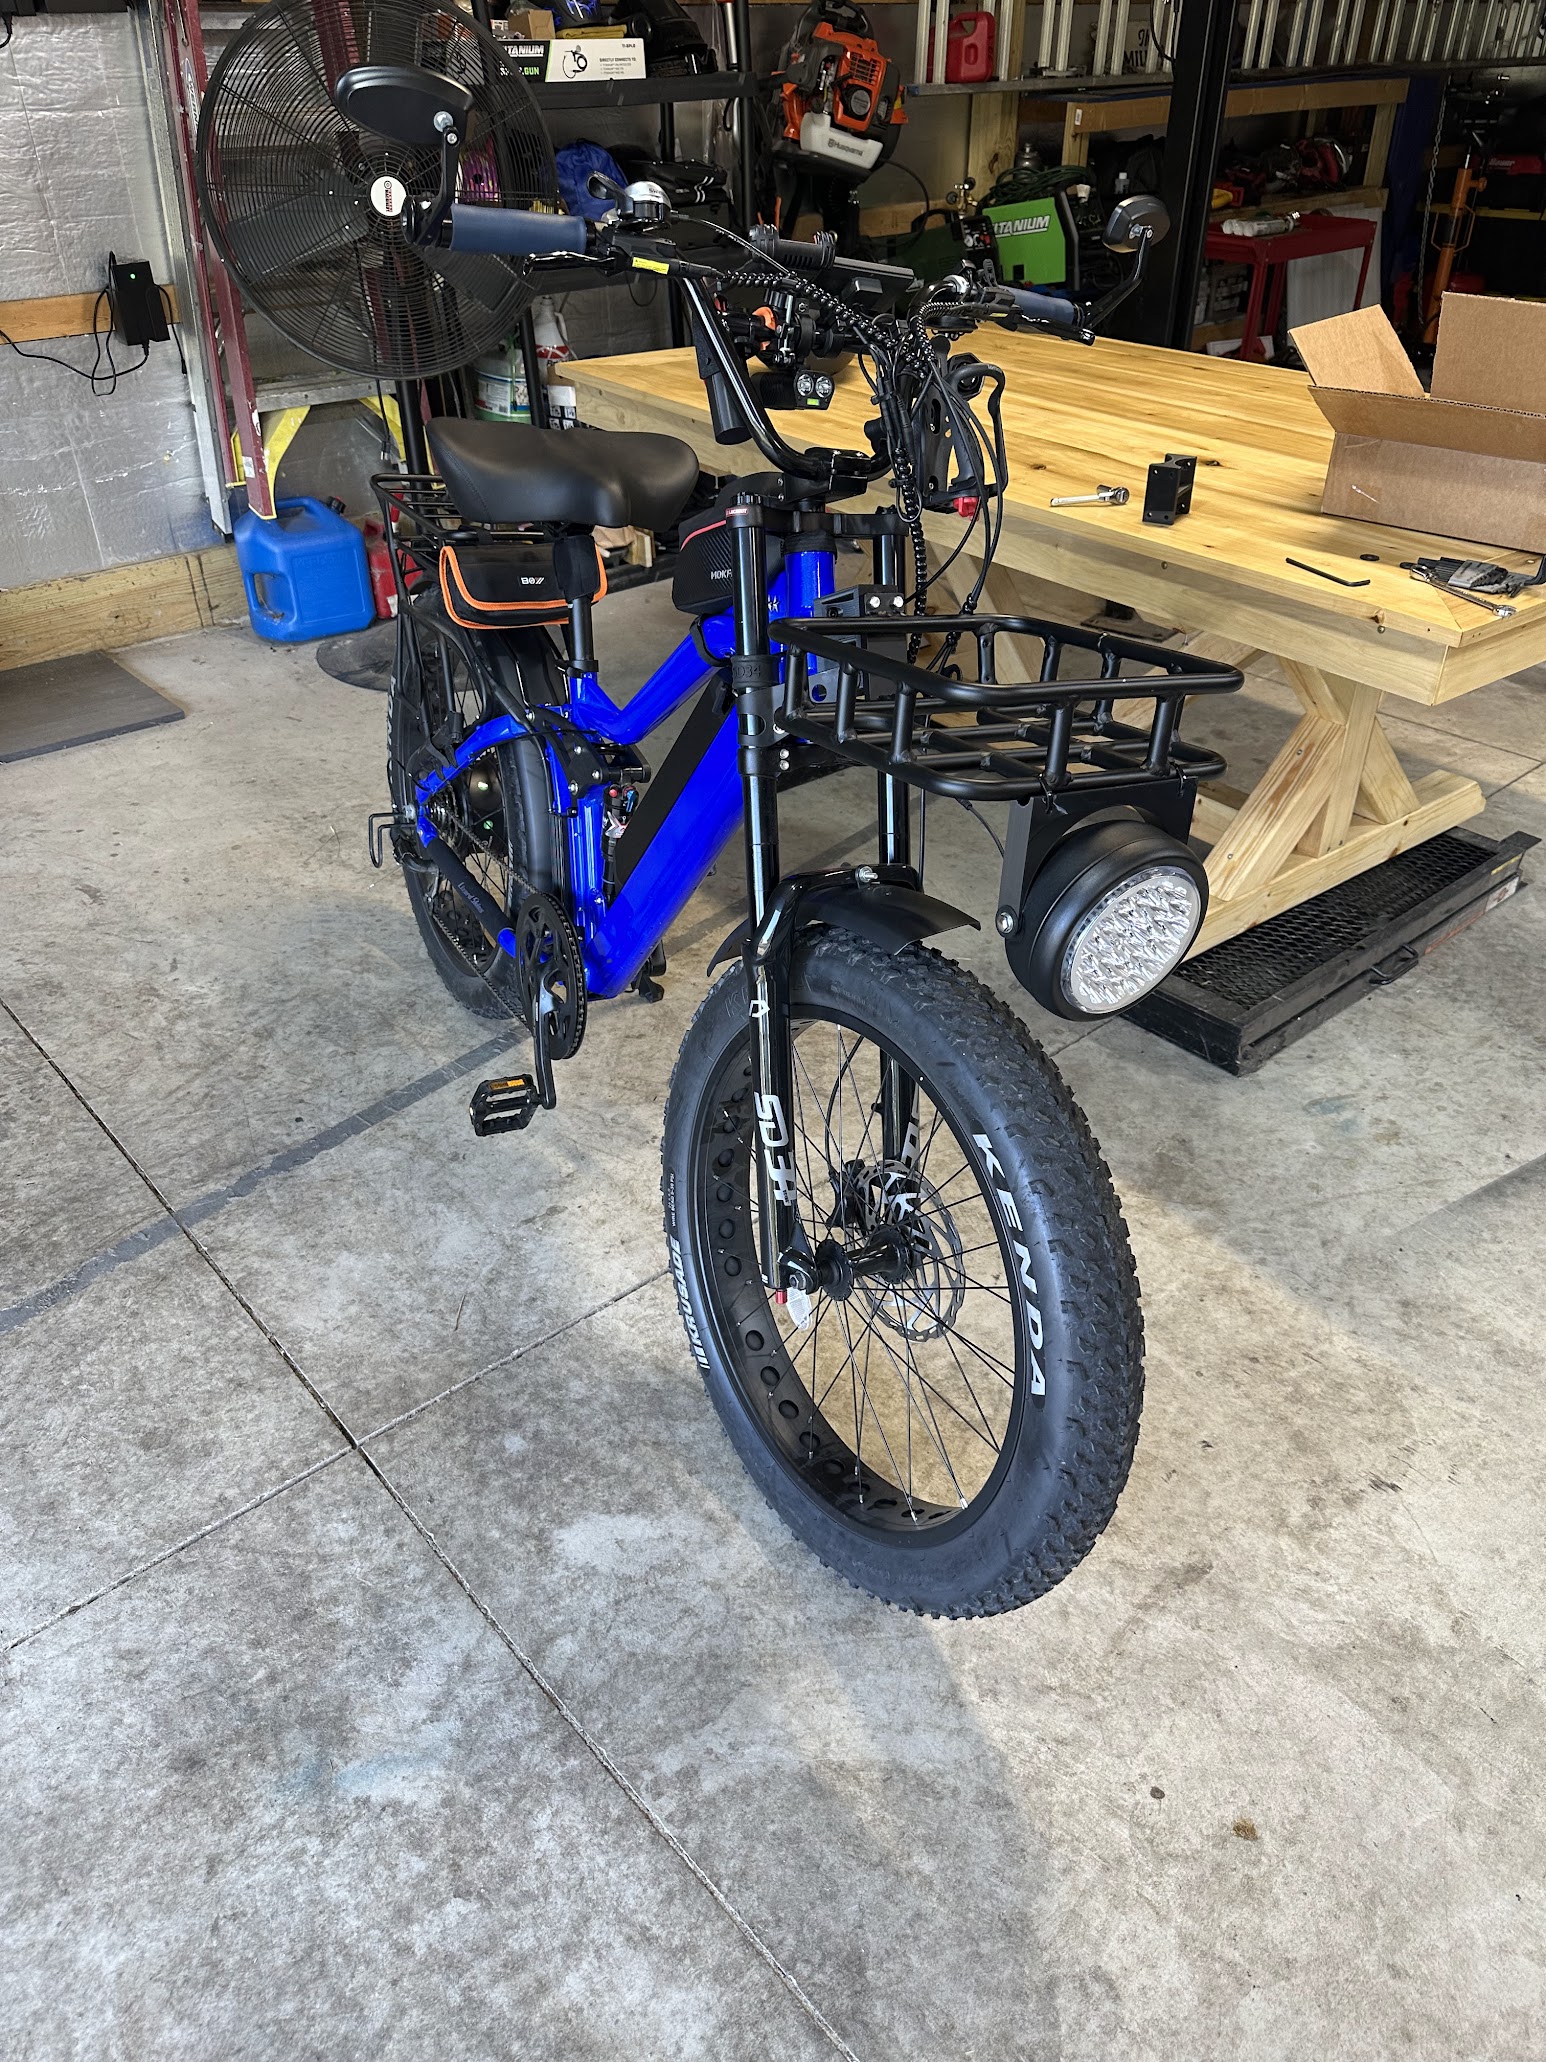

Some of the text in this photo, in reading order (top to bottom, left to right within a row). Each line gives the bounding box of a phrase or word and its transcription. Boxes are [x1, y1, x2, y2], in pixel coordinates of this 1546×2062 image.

[992, 215, 1051, 235] ITANIUM
[669, 1233, 701, 1347] KRUSADE
[971, 1133, 1046, 1396] KENDA
